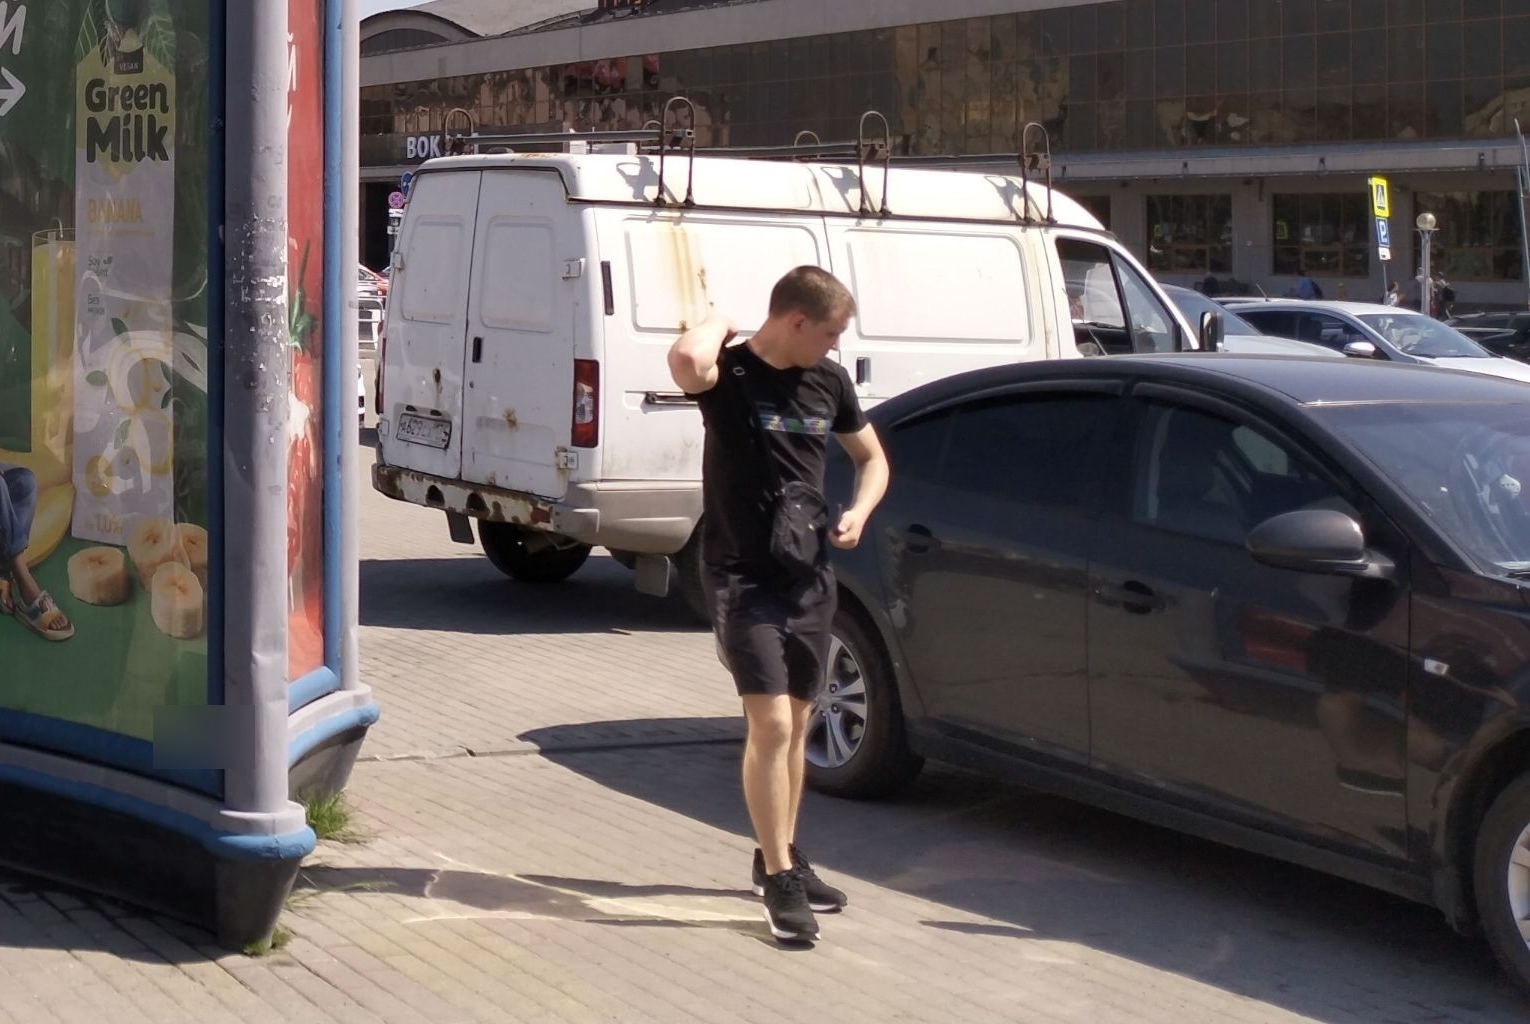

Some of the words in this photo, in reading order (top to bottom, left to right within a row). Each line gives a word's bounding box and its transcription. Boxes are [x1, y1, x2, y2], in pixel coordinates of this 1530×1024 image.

[119, 62, 139, 72] VEGAN
[84, 78, 169, 114] Green
[85, 113, 170, 164] Milk
[406, 135, 441, 158] ВОК
